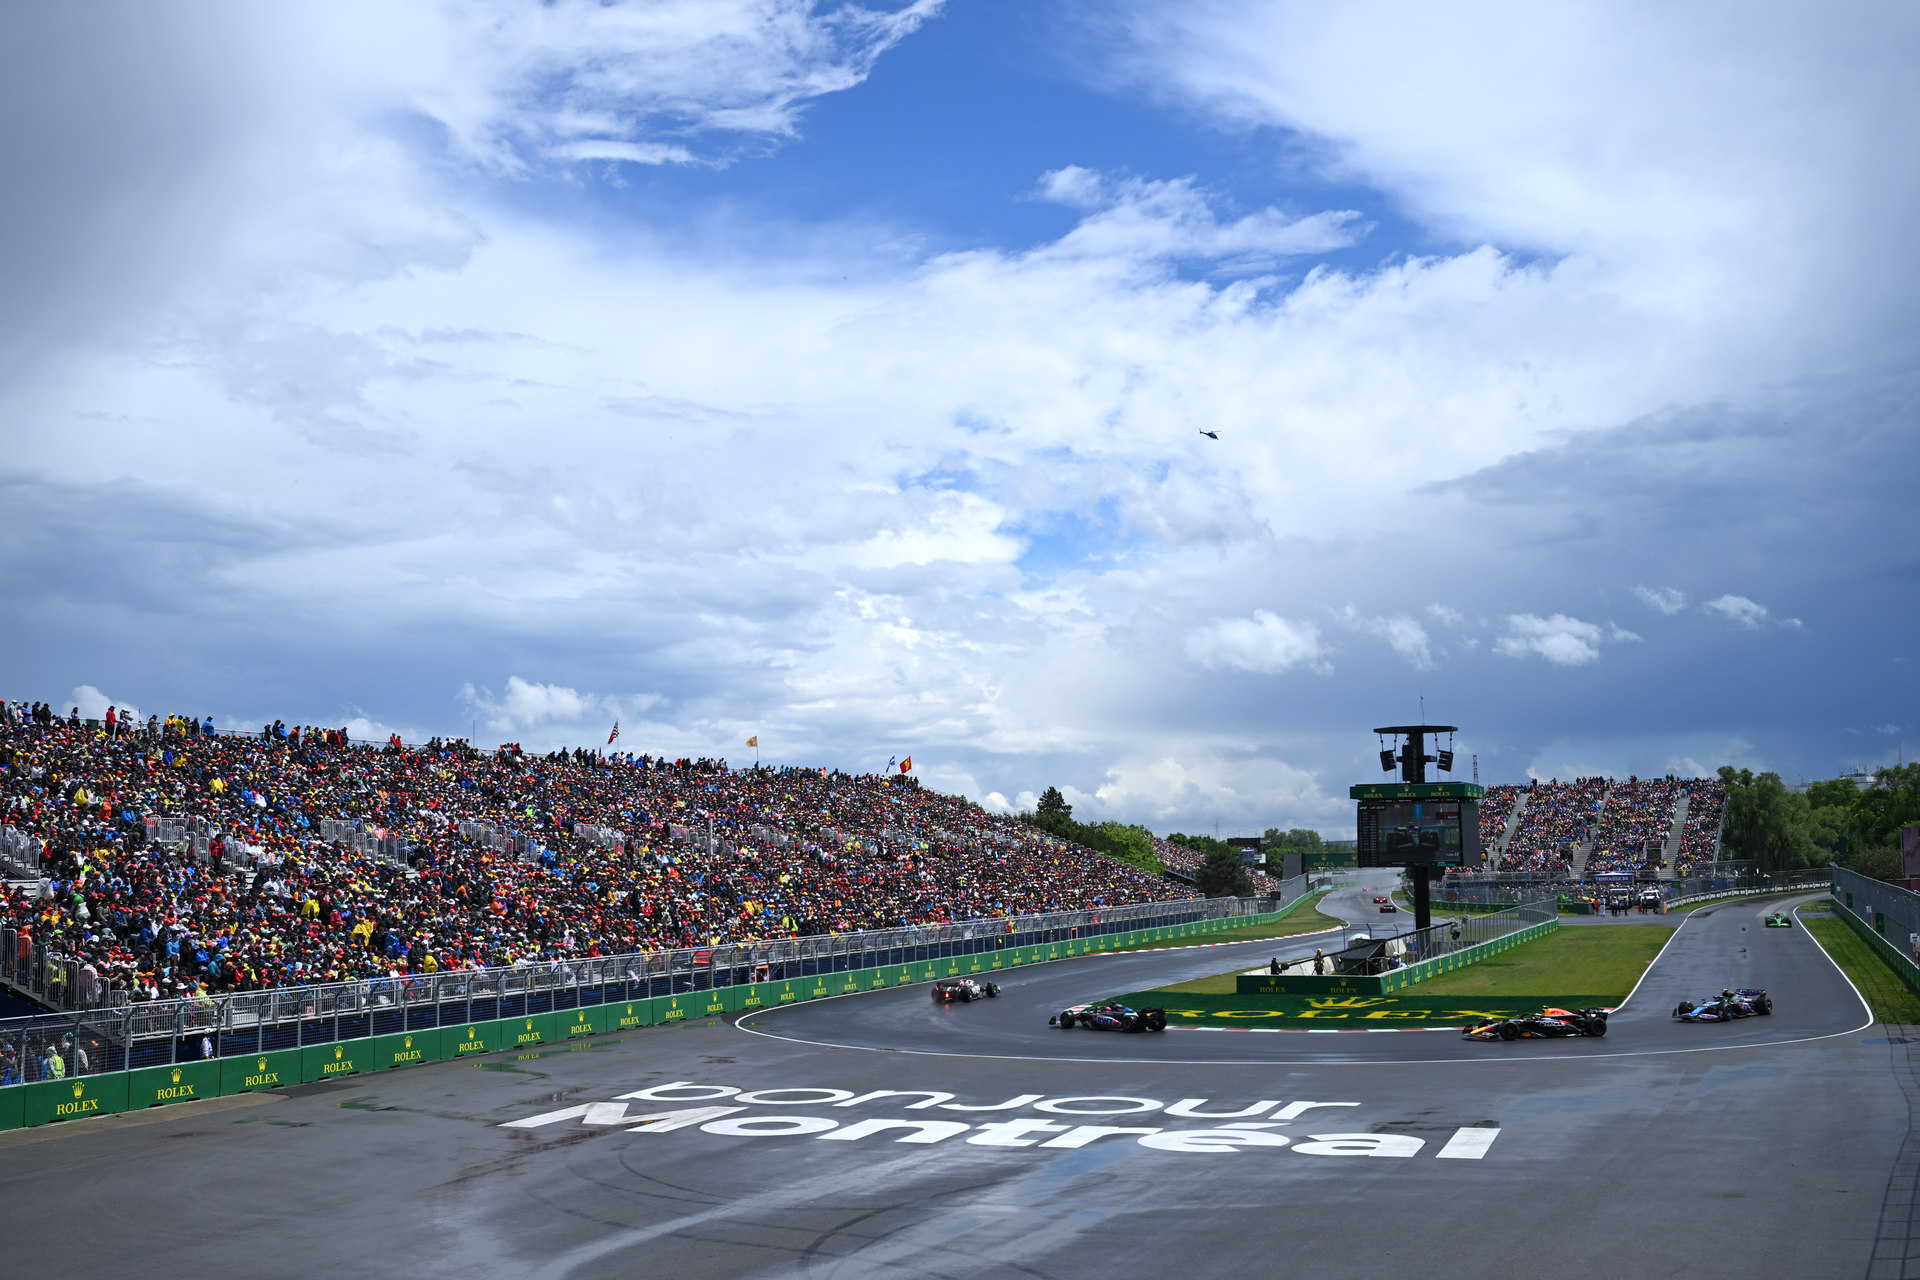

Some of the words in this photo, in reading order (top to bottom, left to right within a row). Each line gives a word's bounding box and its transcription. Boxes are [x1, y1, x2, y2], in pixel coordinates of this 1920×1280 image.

[844, 983, 857, 991] ROLEX
[872, 978, 885, 986] ROLEX
[780, 991, 795, 1001] ROLEX
[813, 987, 827, 996] ROLEX
[745, 996, 761, 1006] ROLEX
[707, 1002, 724, 1012] ROLEX
[665, 1009, 684, 1019] ROLEX
[620, 1016, 640, 1026] ROLEX
[570, 1023, 593, 1034] ROLEX
[517, 1031, 541, 1043] ROLEX
[459, 1040, 485, 1052] ROLEX
[394, 1049, 422, 1063] ROLEX
[323, 1060, 353, 1074] ROLEX
[245, 1072, 279, 1087] ROLEX
[157, 1084, 194, 1100] ROLEX
[610, 1081, 1361, 1120] bonjour
[56, 1098, 99, 1116] ROLEX
[496, 1101, 1501, 1160] Montréal
